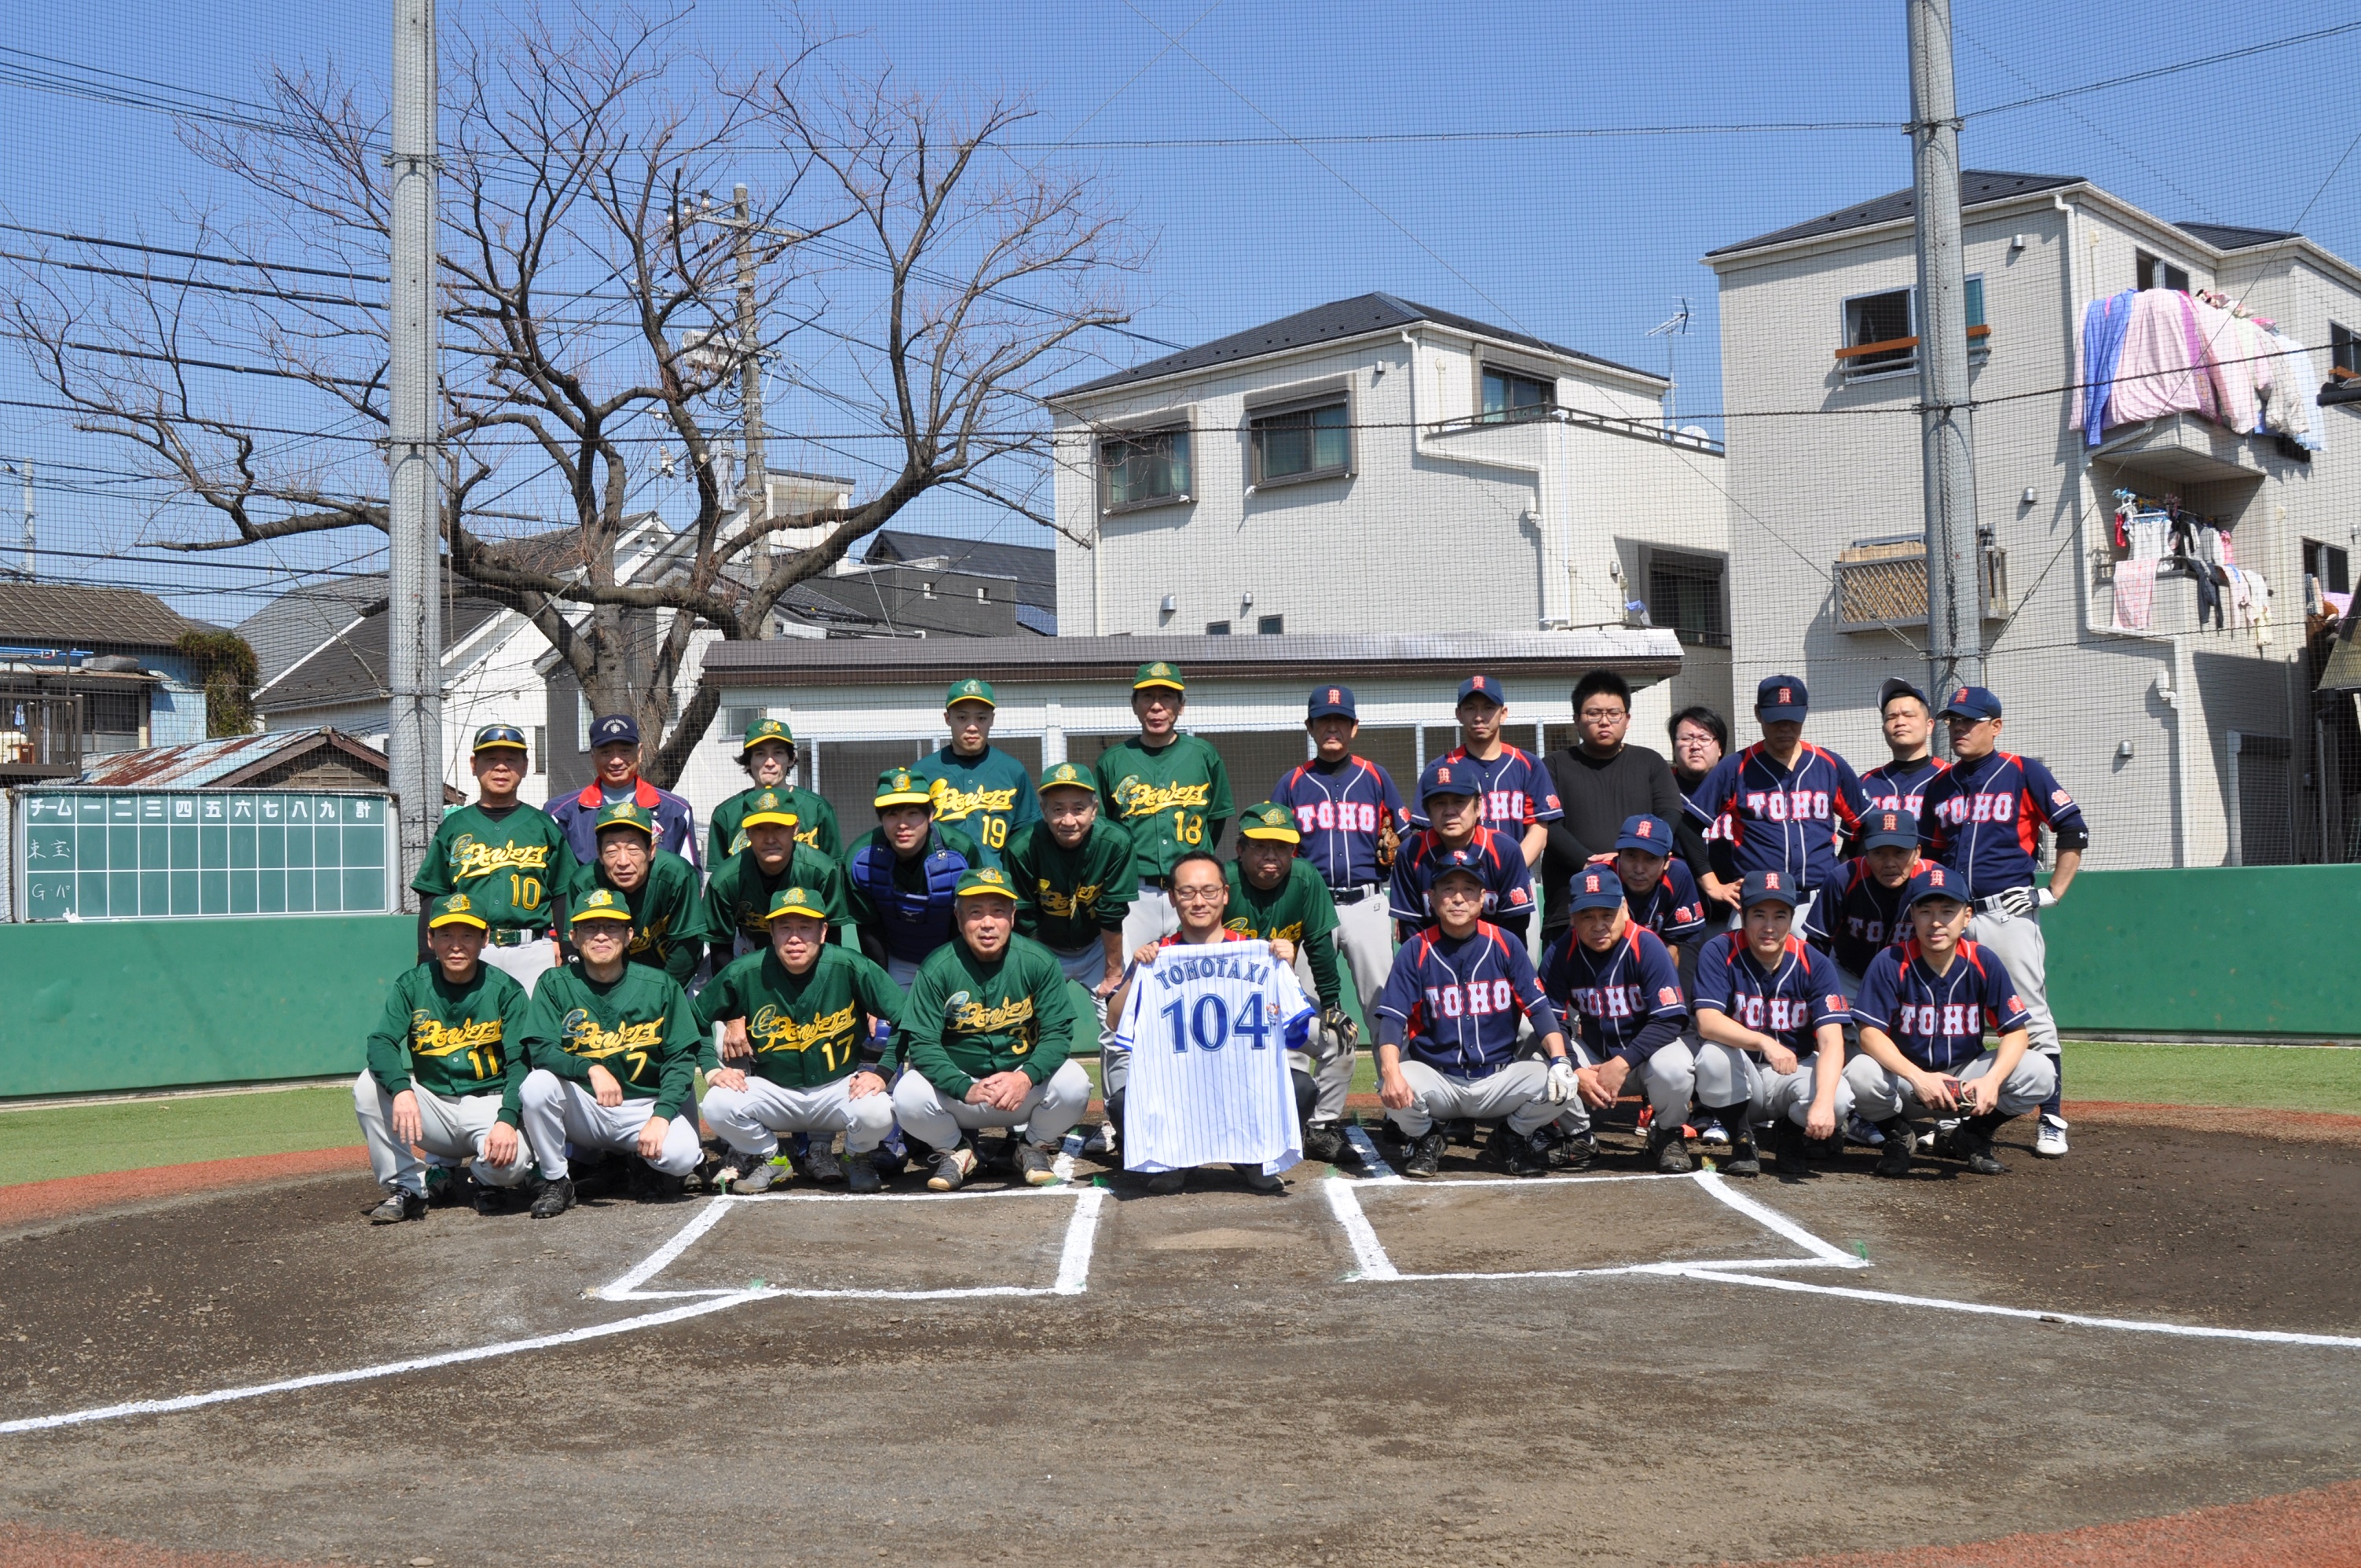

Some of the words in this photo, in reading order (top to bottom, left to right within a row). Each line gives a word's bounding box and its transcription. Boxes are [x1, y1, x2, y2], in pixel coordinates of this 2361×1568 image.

[31, 798, 72, 817] チーム
[115, 800, 133, 817] 二
[145, 800, 163, 817] 三
[175, 801, 193, 818] 四
[205, 801, 222, 818] 五
[234, 799, 252, 818] 六
[262, 800, 279, 819] 七
[292, 801, 308, 819] 八
[319, 801, 335, 819] 九
[355, 801, 371, 819] 計
[1296, 801, 1376, 834] TOHO
[1747, 790, 1829, 821] TOHO
[1934, 792, 2015, 829] TOHO
[982, 815, 1007, 848] 19
[1174, 811, 1203, 845] 18
[510, 874, 541, 911] 10
[1155, 957, 1270, 990] TOHOTAXI
[1424, 977, 1512, 1020] TOHO
[1571, 984, 1647, 1019] TOHO
[1733, 991, 1810, 1032] TOHO
[1009, 1019, 1040, 1055] 30
[1161, 991, 1272, 1054] 104
[1900, 1003, 1980, 1036] TOHO
[468, 1045, 499, 1080] 11
[626, 1051, 647, 1082] 7
[821, 1033, 855, 1072] 17
